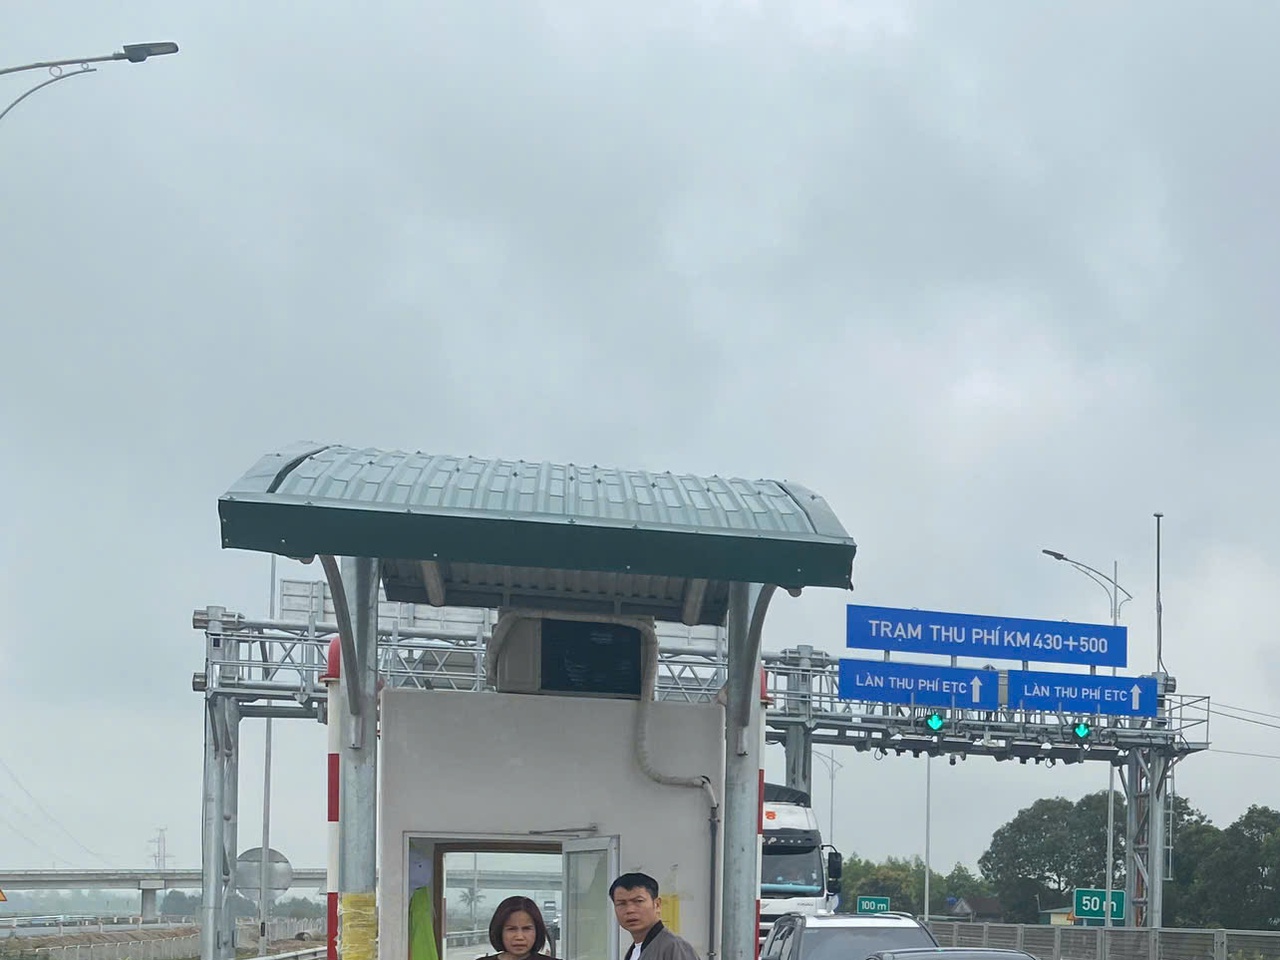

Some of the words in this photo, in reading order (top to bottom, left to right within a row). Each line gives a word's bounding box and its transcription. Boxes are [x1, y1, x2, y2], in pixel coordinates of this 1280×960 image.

[868, 619, 922, 642] TRẠM
[929, 624, 966, 643] THU
[972, 625, 1001, 646] PHÍ
[856, 672, 884, 688] LÀN
[889, 676, 914, 690] THU
[918, 677, 940, 692] PHÍ
[942, 681, 967, 694] ETC
[1024, 682, 1050, 697] LÀN
[1054, 686, 1078, 699] THU
[1081, 686, 1102, 701] PHÍ
[1104, 689, 1128, 702] ETC
[861, 901, 876, 910] 100
[877, 903, 887, 911] m
[1082, 896, 1100, 911] 50
